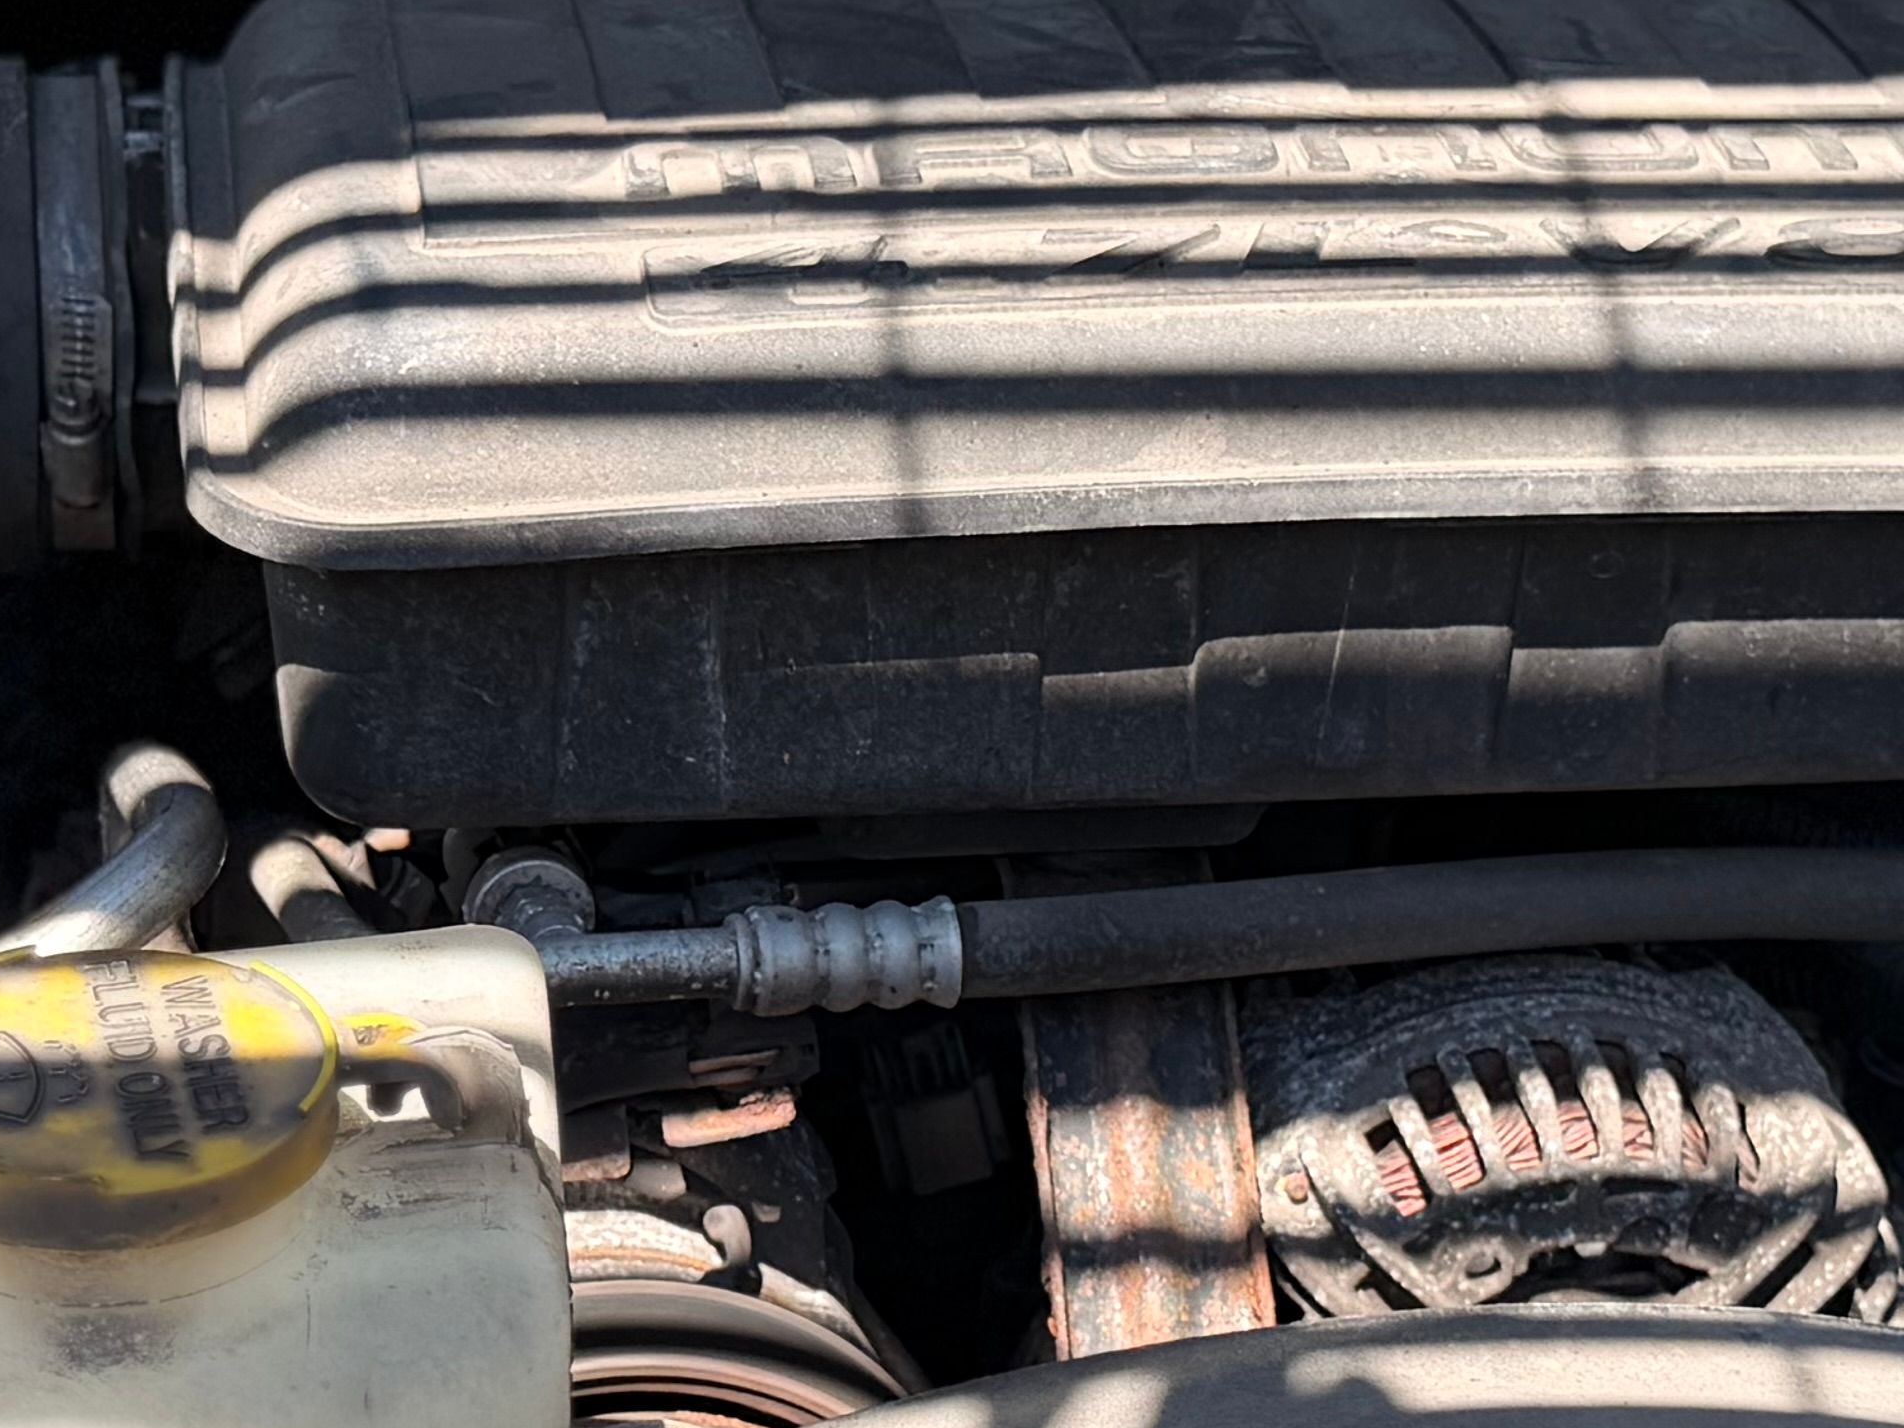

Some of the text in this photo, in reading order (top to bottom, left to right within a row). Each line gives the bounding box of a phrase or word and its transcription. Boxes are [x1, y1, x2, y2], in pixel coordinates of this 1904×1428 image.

[82, 959, 191, 1160] FLUID ONLY
[159, 974, 249, 1134] WASHER
